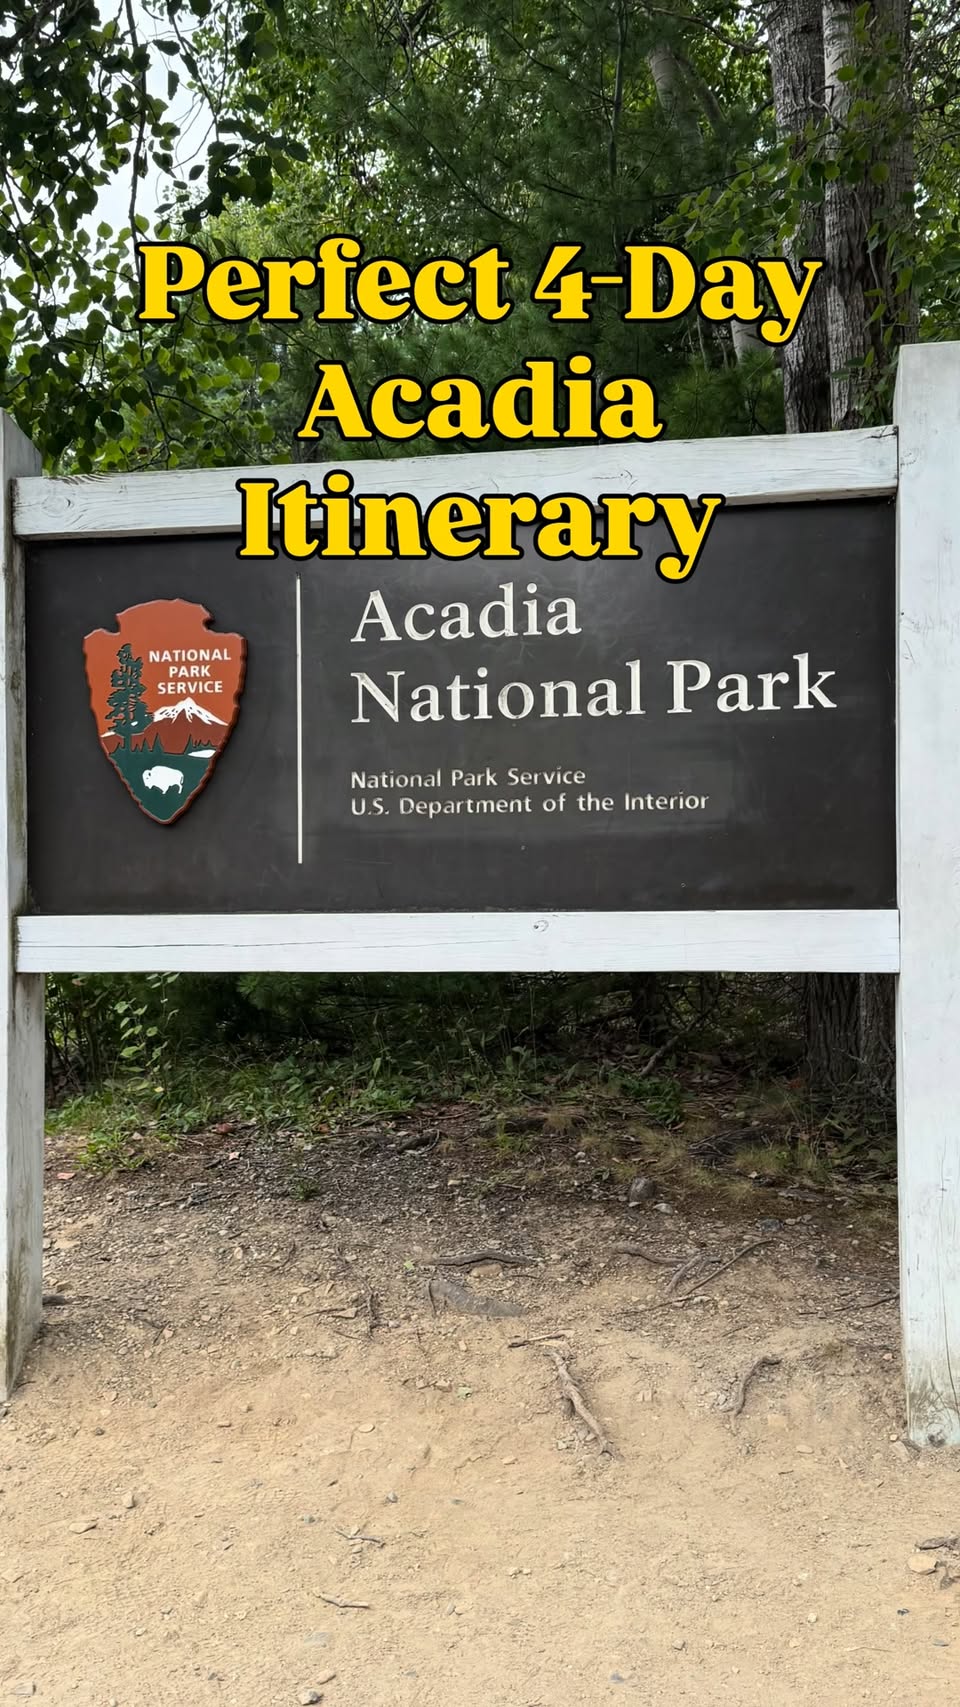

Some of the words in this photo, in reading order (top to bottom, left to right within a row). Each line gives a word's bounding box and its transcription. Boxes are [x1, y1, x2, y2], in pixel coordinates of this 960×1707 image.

[350, 581, 582, 643] Acadia
[148, 648, 232, 663] NATIONAL
[168, 665, 211, 678] PARK
[157, 680, 223, 695] SERVICE
[350, 659, 647, 724] National
[666, 652, 838, 714] Park
[351, 768, 442, 790] National
[451, 768, 498, 788] Park
[507, 765, 586, 786] Service
[351, 797, 390, 816] U.S.
[399, 794, 533, 819] Department
[542, 793, 566, 813] of
[576, 792, 614, 812] the
[624, 790, 710, 811] Interior
